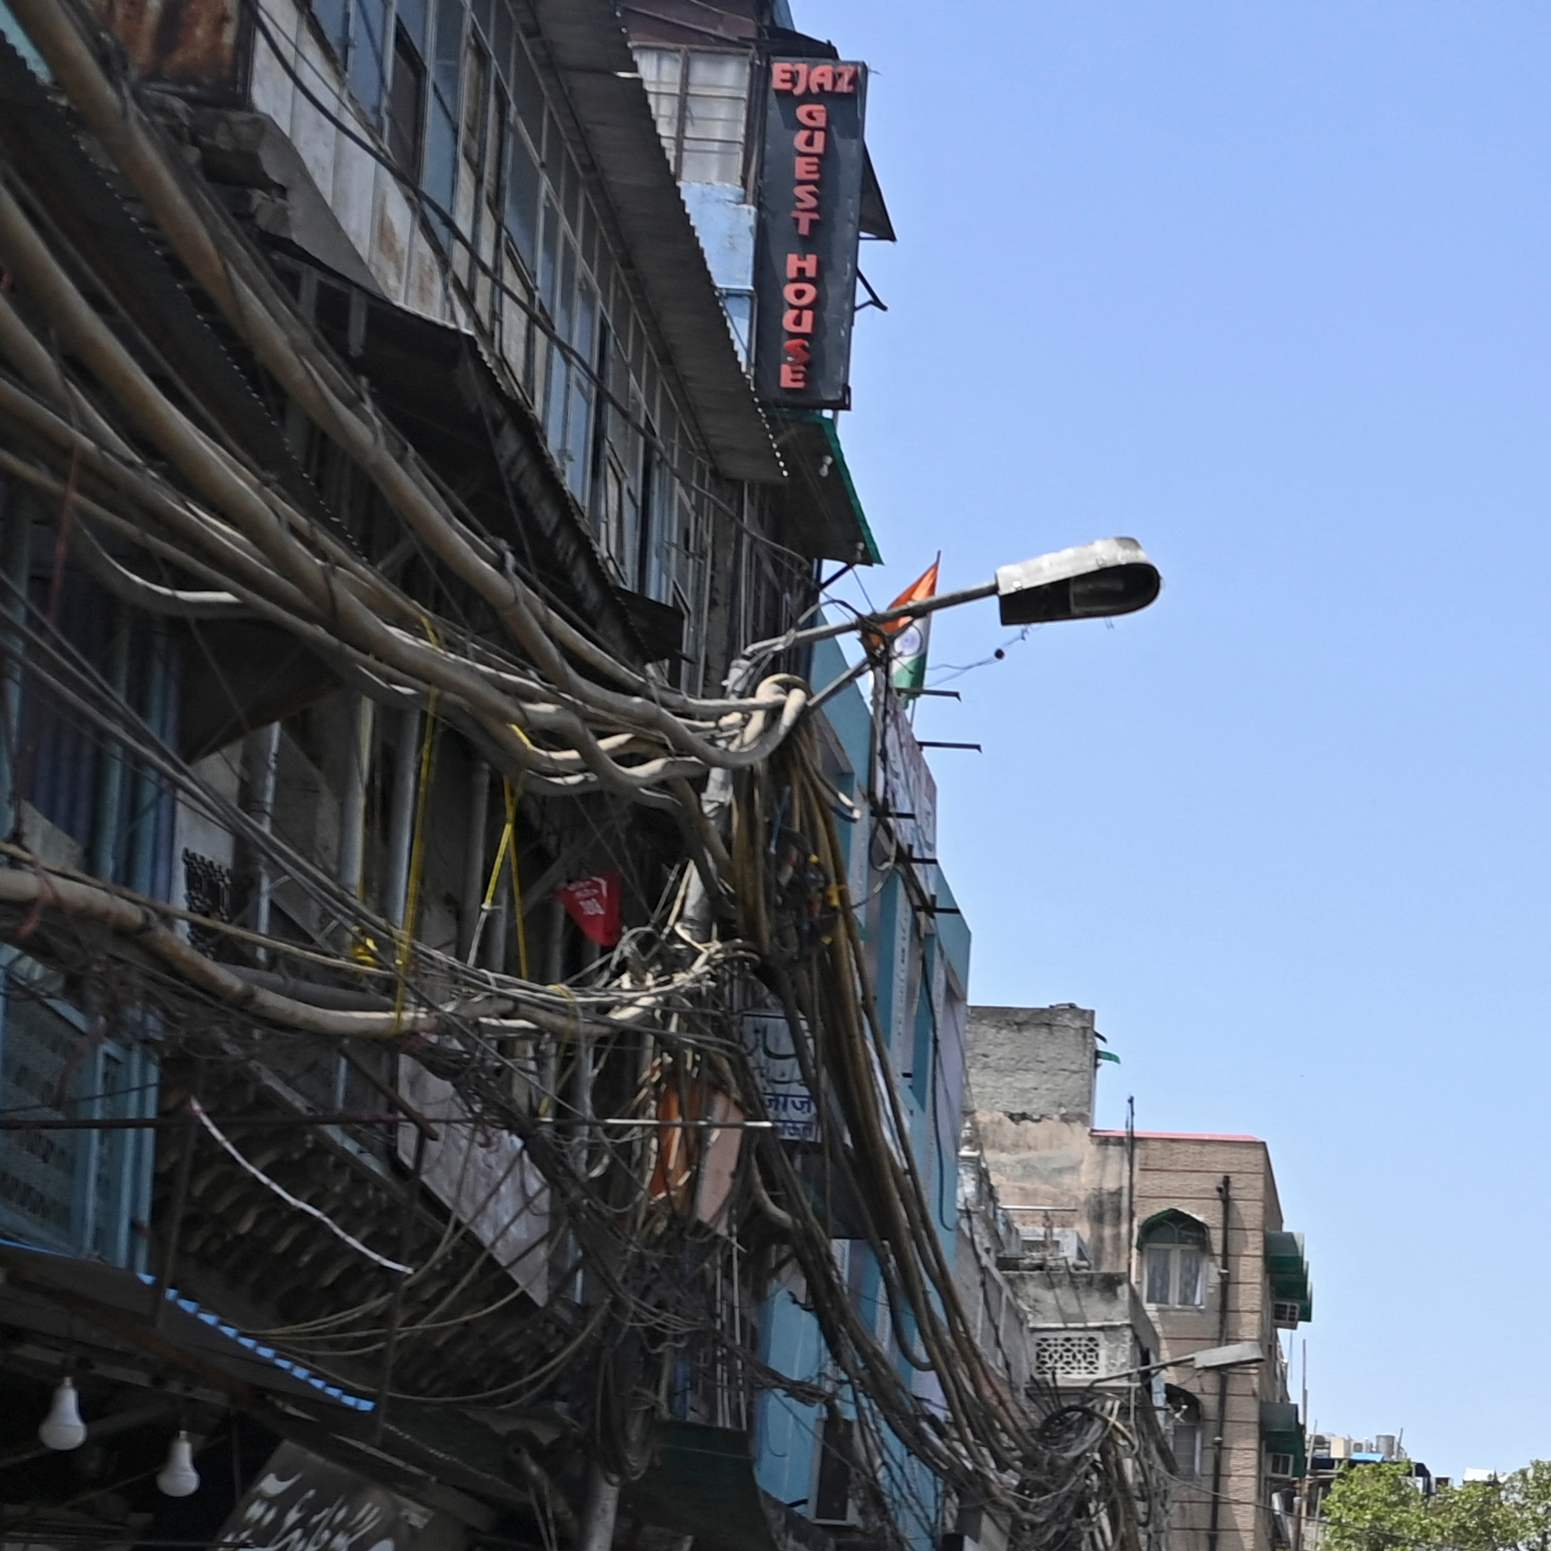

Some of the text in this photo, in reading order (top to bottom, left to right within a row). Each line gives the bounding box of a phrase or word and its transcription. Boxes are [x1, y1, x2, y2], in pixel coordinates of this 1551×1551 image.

[771, 61, 857, 95] EJAZ
[780, 103, 827, 390] GUEST HOUSE
